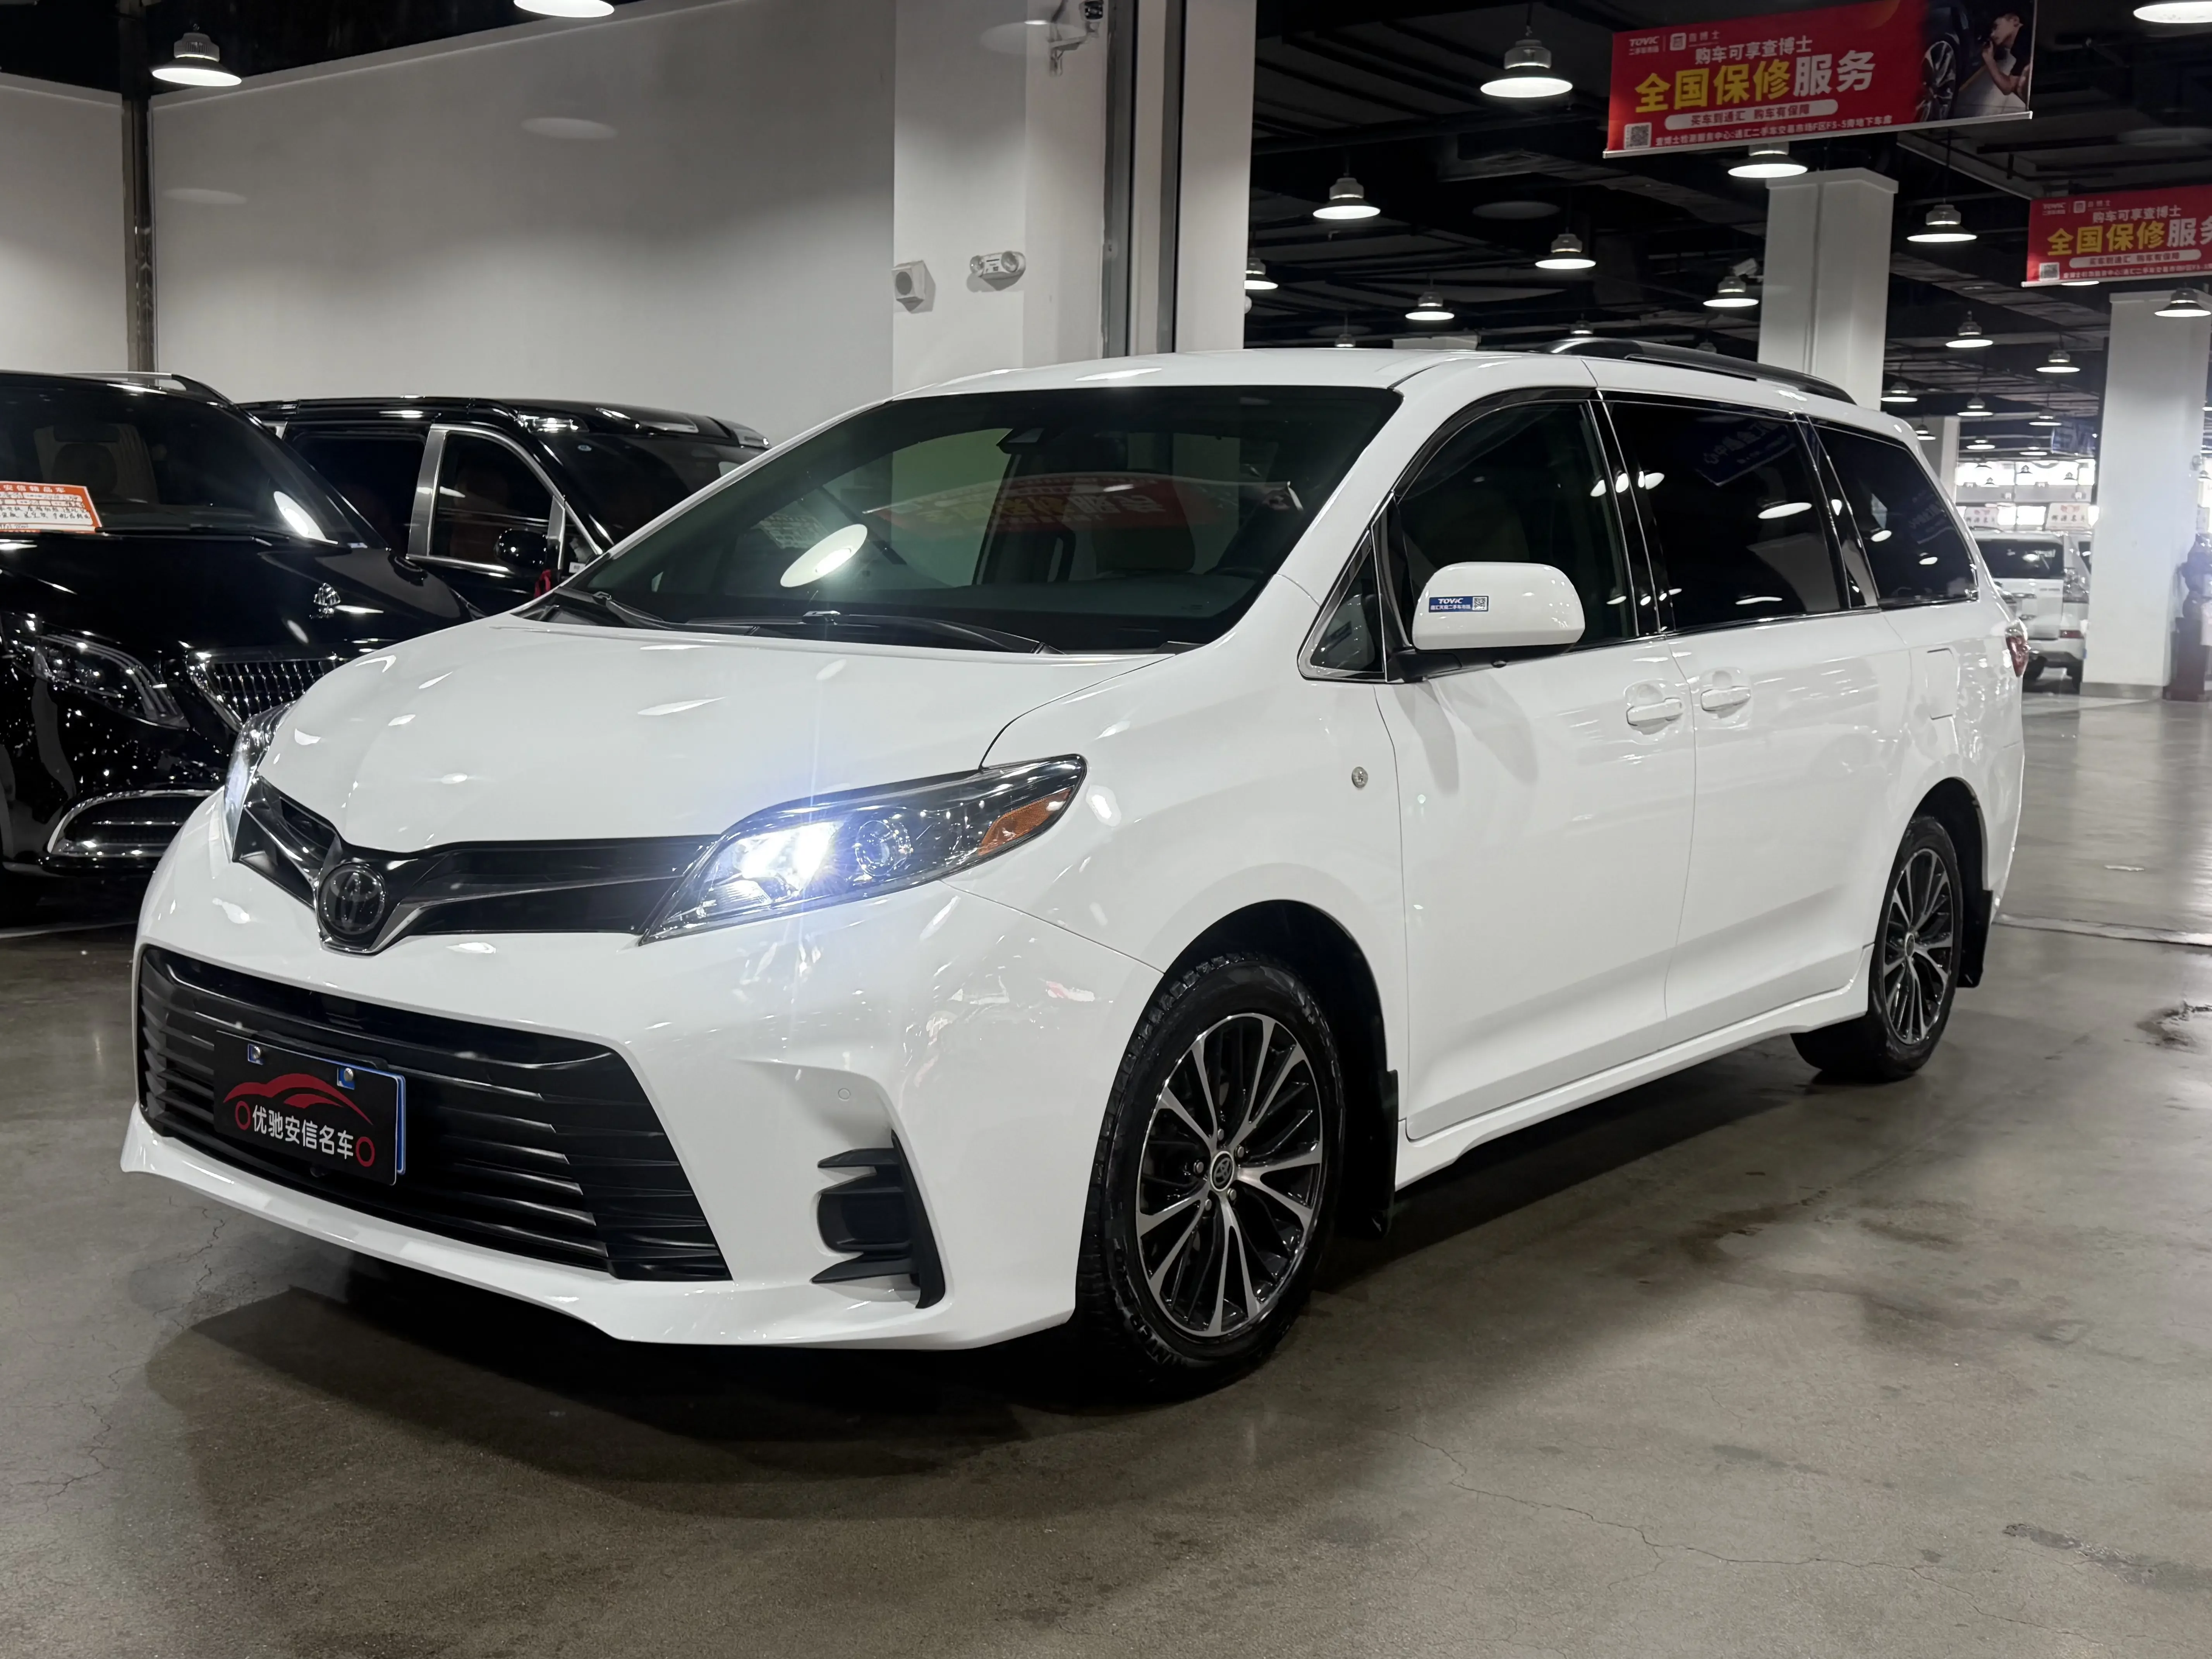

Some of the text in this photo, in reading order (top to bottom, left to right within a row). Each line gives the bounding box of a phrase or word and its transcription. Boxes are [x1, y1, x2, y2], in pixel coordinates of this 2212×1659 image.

[1695, 35, 1813, 65] 购车可享查博士
[1635, 50, 1876, 113] 全国保修服务
[252, 1105, 354, 1159] 优驰安信名车
